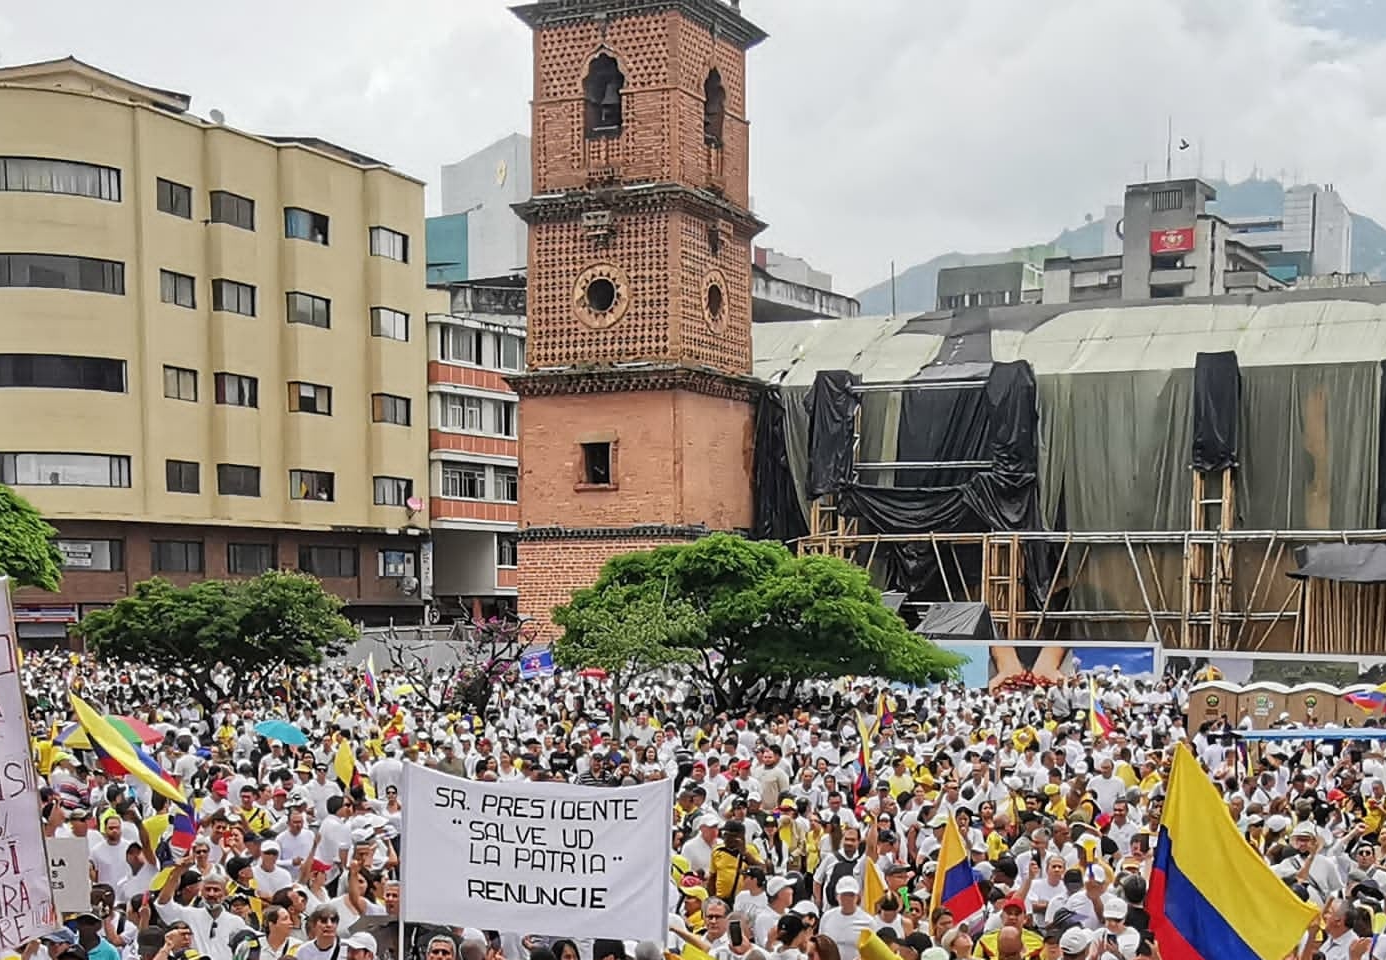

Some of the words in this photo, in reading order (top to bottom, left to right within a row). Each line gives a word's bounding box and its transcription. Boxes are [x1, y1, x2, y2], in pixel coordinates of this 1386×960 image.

[435, 786, 470, 811] SR.
[481, 794, 639, 821] PRESIDENTE
[562, 828, 594, 849] UD
[469, 843, 501, 867] LA
[467, 879, 608, 909] RENUNCIE
